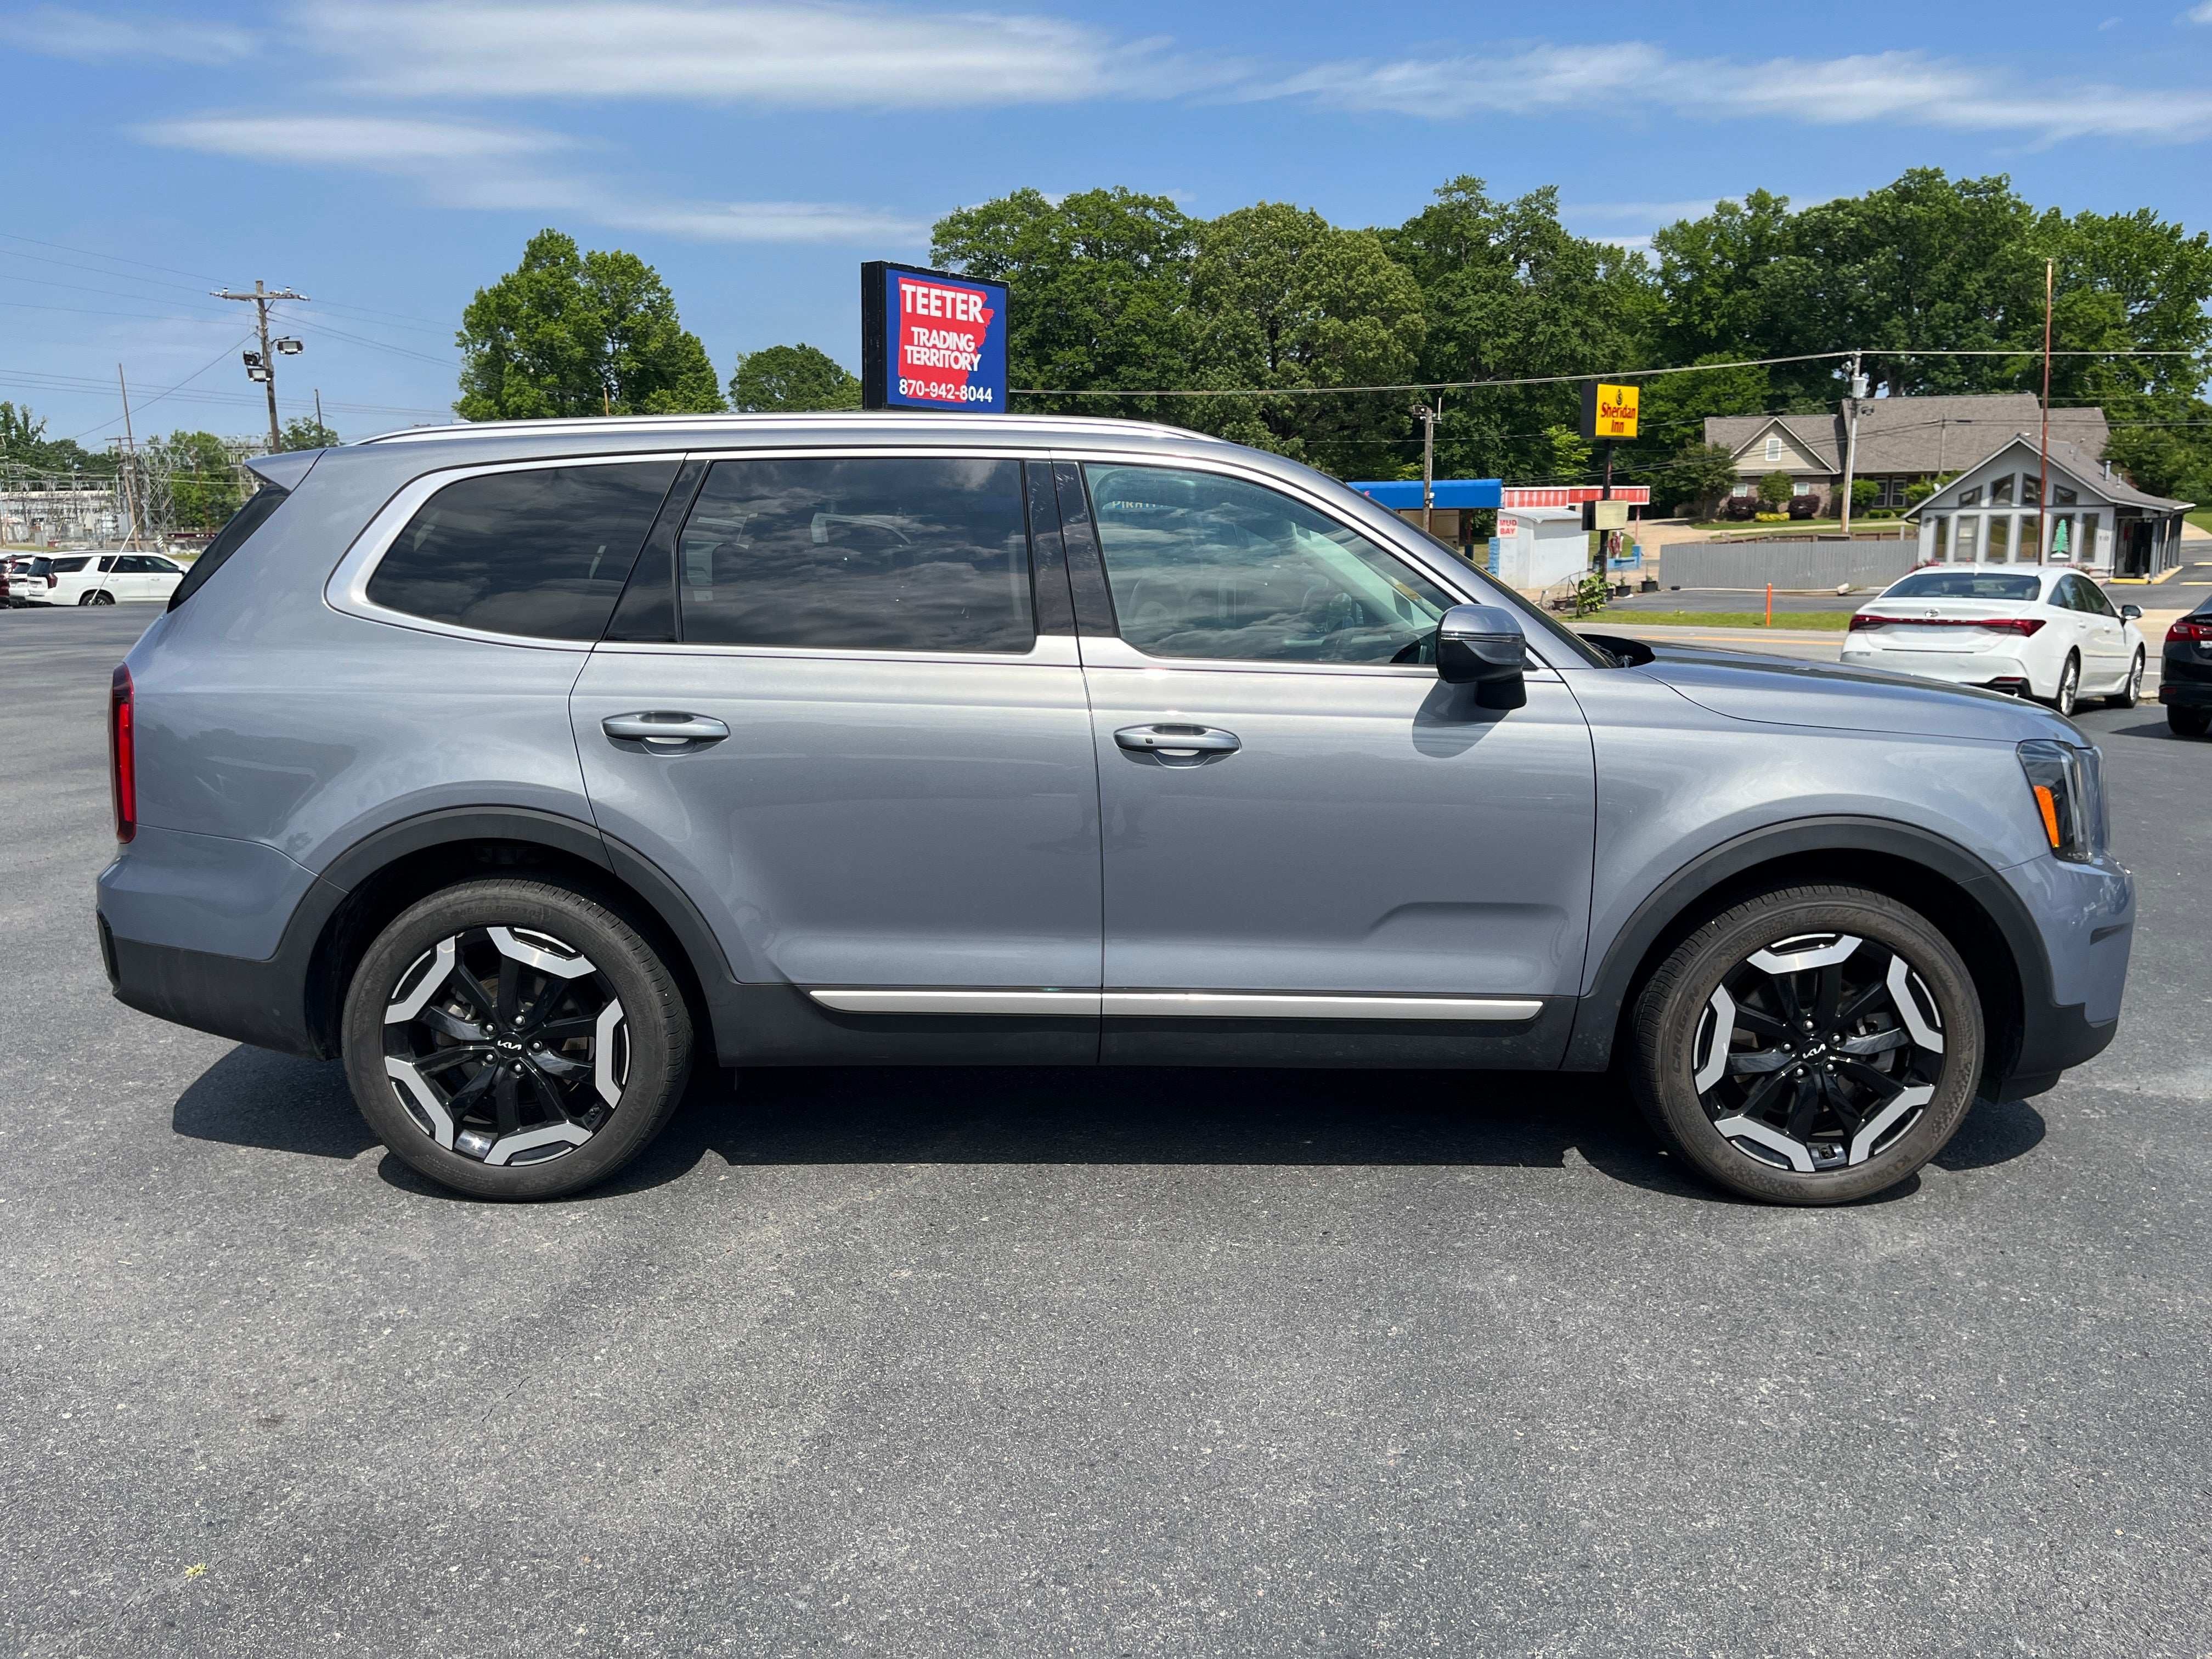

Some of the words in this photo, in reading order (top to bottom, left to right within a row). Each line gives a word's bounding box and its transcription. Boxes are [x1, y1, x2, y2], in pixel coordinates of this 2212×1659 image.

[901, 284, 985, 323] TEETER
[911, 326, 975, 352] TRADING
[904, 345, 981, 371] TERRITORY
[899, 379, 993, 403] 870-942-8044
[1601, 402, 1636, 419] Sheridan
[1611, 420, 1624, 433] Inn
[1673, 985, 1700, 1074] CRUGEN
